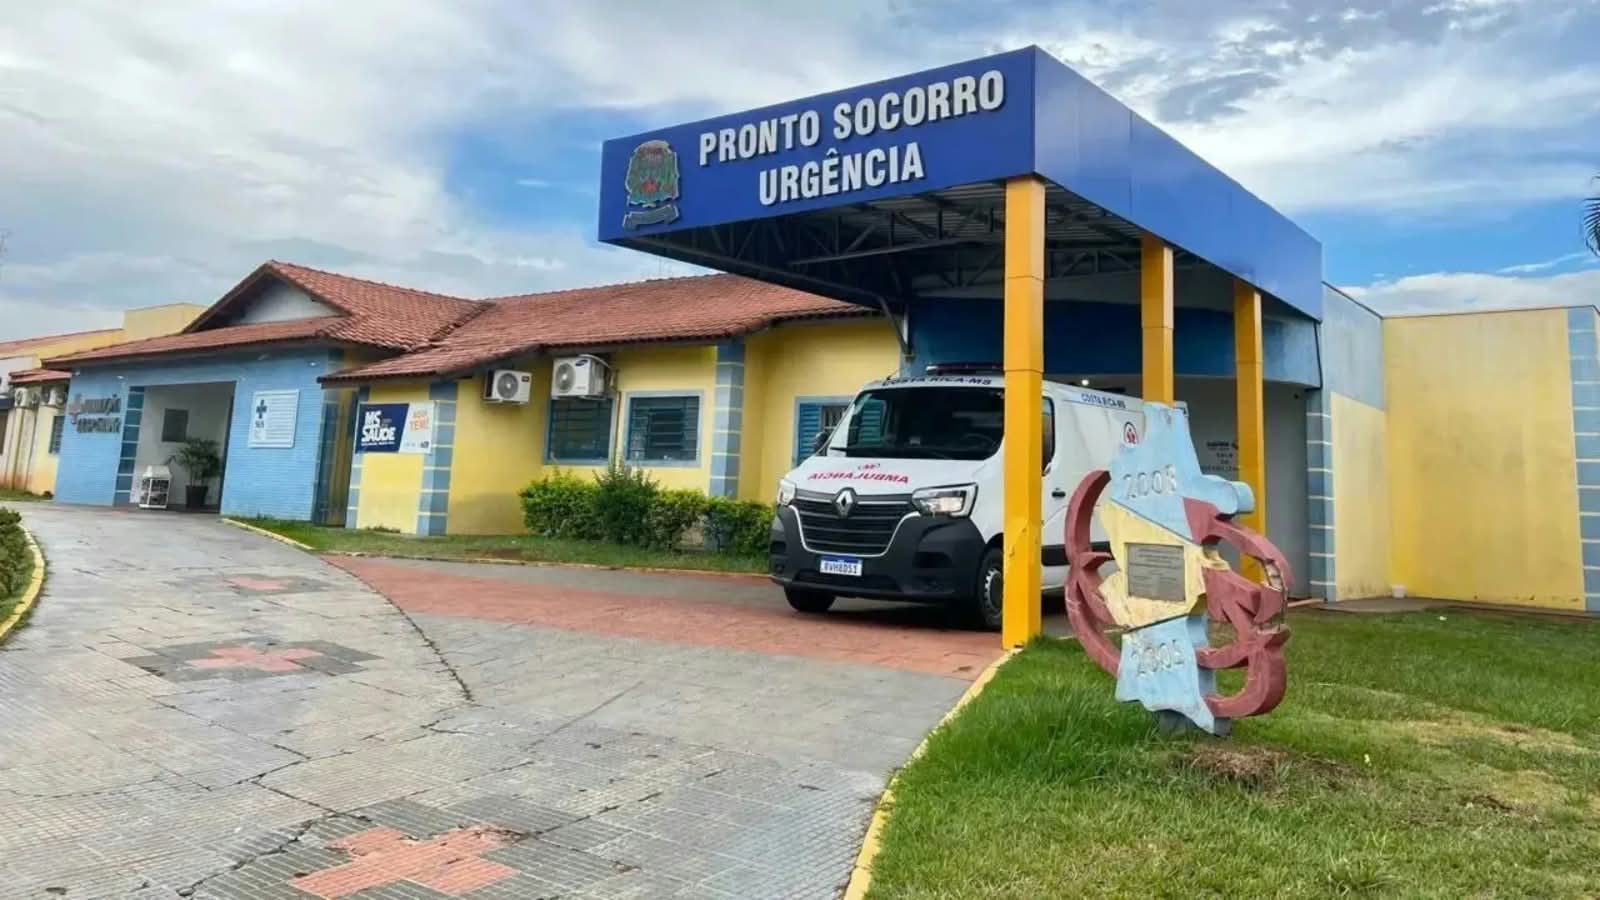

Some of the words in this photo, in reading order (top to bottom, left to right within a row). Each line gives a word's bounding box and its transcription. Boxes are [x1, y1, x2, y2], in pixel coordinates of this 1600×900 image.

[699, 110, 821, 167] PRONTO
[832, 70, 1005, 140] SOCORRO
[758, 142, 925, 206] URGÊNCIA
[365, 411, 381, 426] MS
